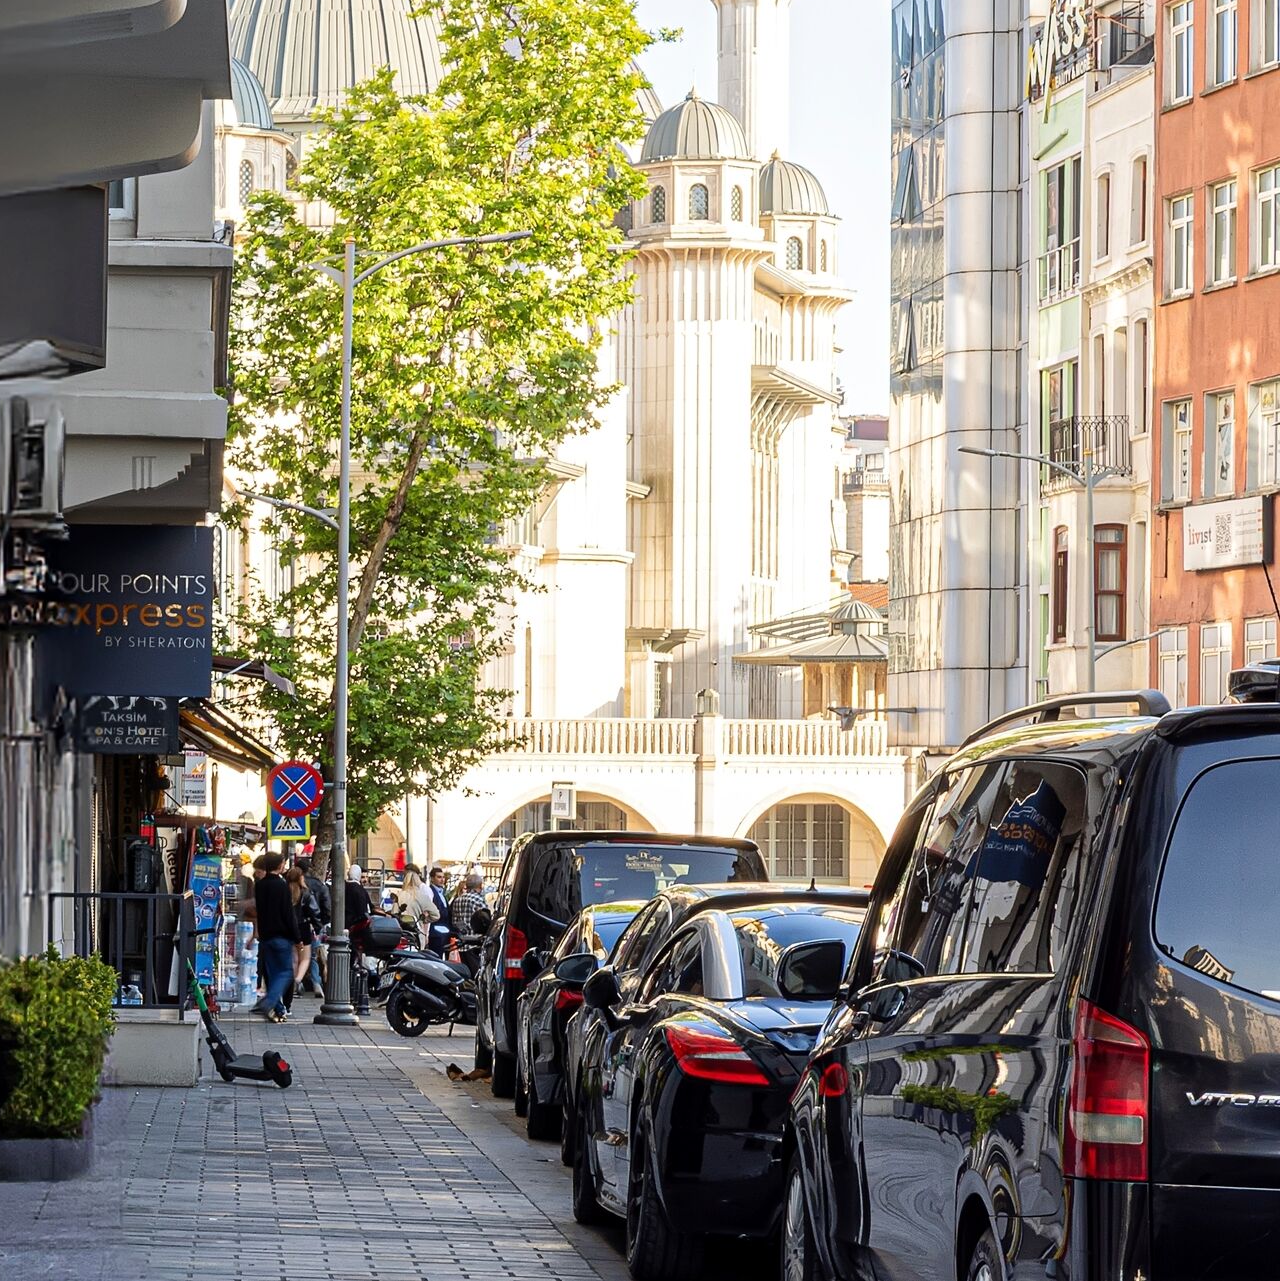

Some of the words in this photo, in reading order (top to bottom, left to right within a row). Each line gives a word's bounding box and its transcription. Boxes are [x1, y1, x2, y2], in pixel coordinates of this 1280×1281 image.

[58, 573, 111, 595] OUR
[120, 573, 207, 595] POINTS
[105, 635, 122, 647] BY
[128, 636, 206, 649] SHERATON
[114, 736, 121, 745] &
[1185, 1092, 1256, 1106] VITO
